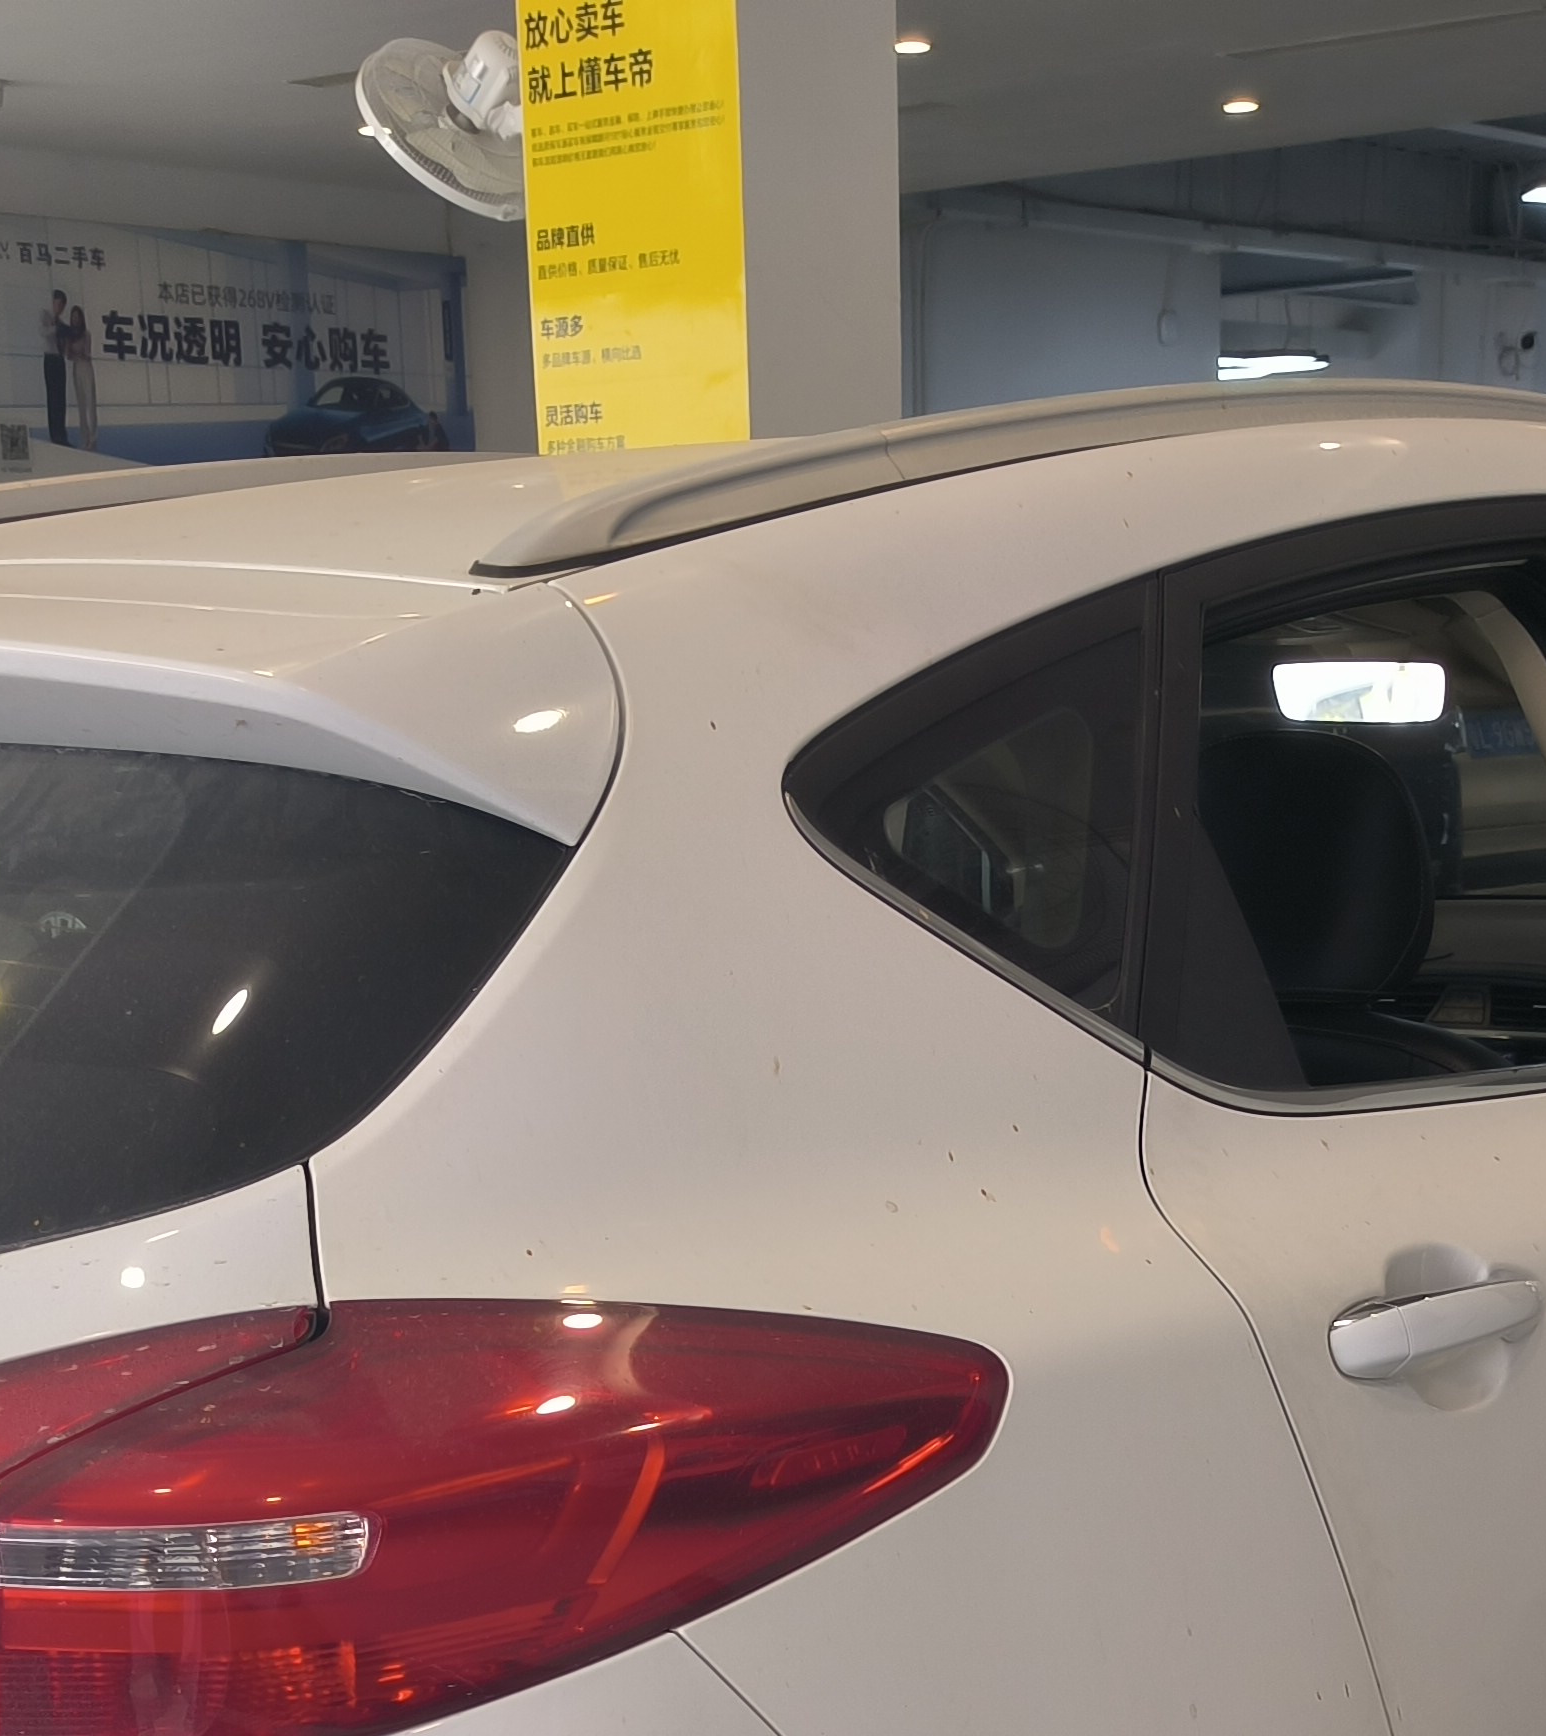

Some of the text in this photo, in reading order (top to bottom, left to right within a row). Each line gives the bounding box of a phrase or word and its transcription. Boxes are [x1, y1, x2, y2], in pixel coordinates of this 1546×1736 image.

[524, 0, 625, 51] 放心卖车
[527, 48, 654, 104] 就上懂车帝
[536, 222, 596, 251] 品牌直供
[16, 241, 106, 271] 百马二手车
[540, 314, 584, 341] 车源多
[101, 310, 391, 376] 车况透明 安心购车
[545, 401, 603, 428] 灵活购车
